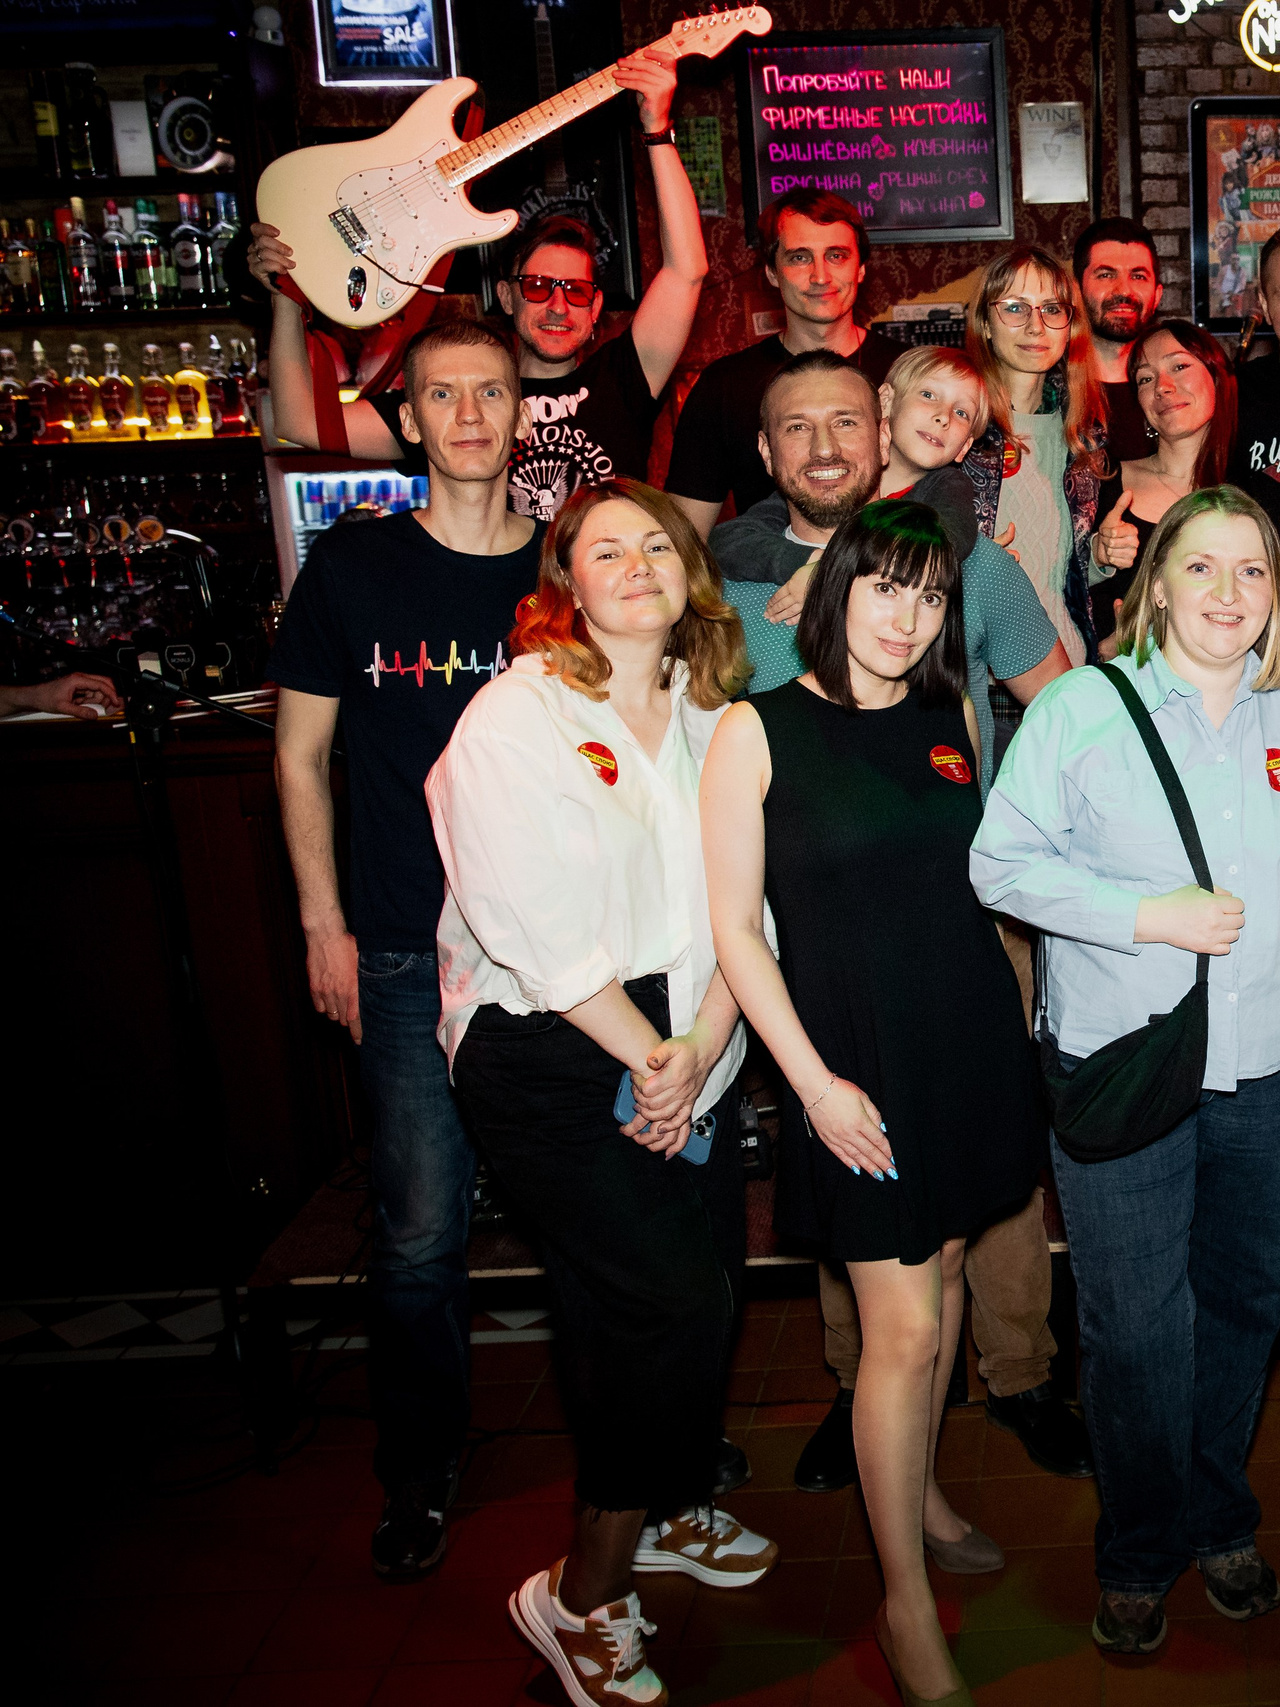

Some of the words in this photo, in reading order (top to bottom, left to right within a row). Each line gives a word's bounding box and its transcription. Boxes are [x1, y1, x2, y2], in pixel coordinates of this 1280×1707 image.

[382, 21, 429, 46] SALE
[900, 68, 951, 89] НАШИ
[761, 105, 883, 130] ФИРМЕННЫЕ
[889, 99, 988, 127] НАСТОЙКИ
[1026, 107, 1077, 122] WINE
[903, 138, 989, 158] КЛУБНИКА
[1249, 440, 1267, 472] В.
